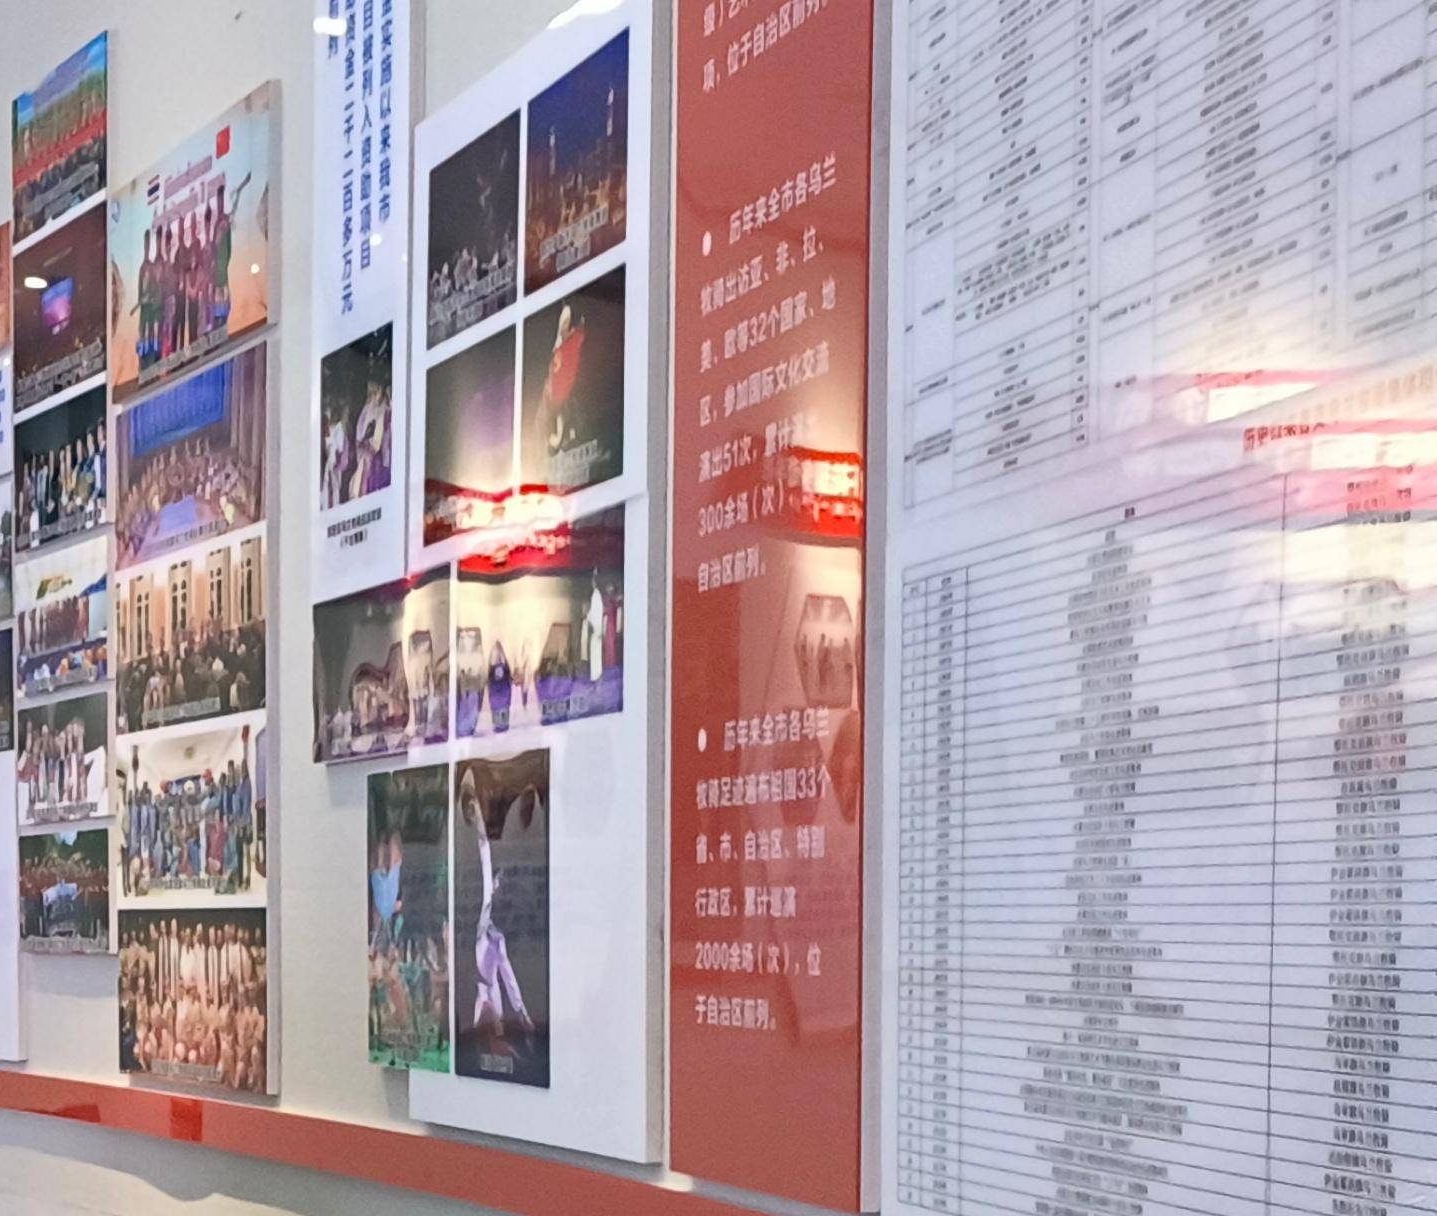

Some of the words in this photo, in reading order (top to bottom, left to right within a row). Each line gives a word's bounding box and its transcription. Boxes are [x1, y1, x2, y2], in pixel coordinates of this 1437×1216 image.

[729, 151, 836, 244] 历年来全市各乌兰
[724, 706, 830, 751] 历年来全市各乌兰
